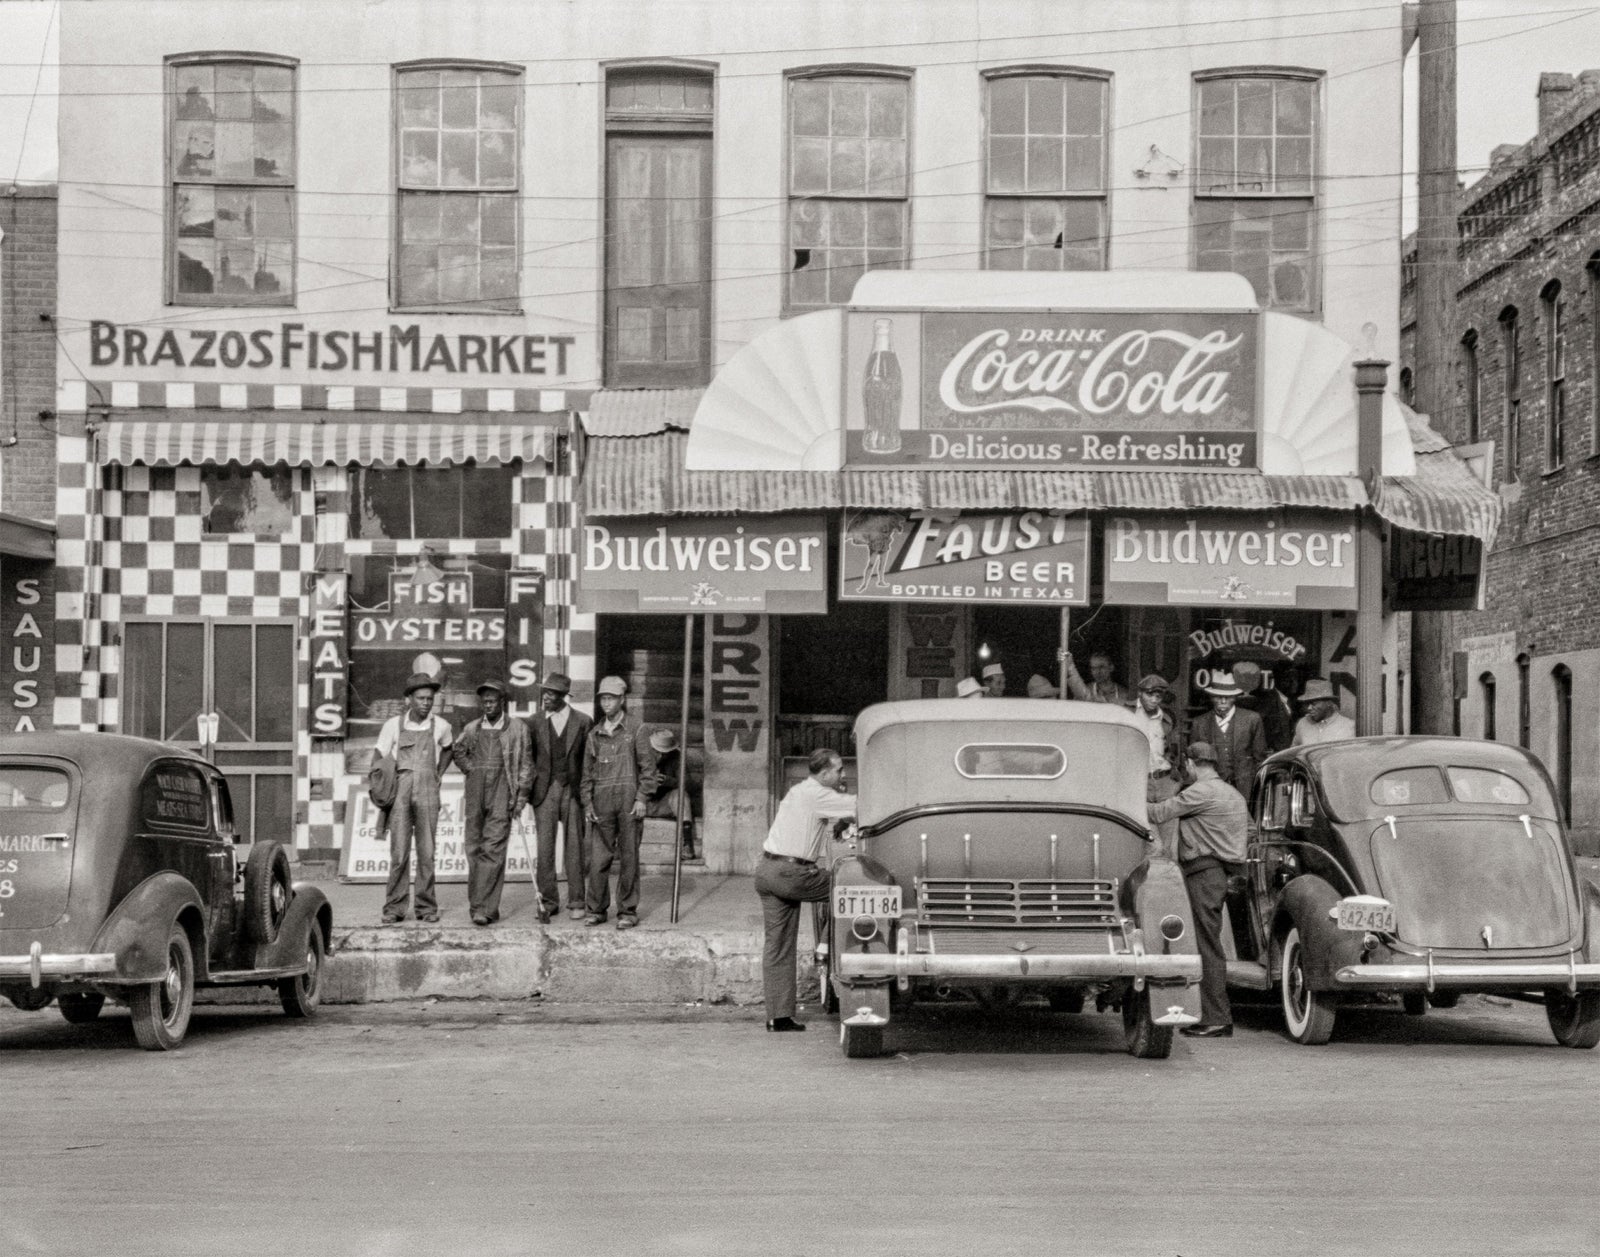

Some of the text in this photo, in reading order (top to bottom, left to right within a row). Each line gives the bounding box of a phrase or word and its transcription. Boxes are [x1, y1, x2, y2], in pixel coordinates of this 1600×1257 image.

[90, 320, 575, 375] BRAZOS FISH MARKET
[1017, 328, 1107, 342] DRINK
[939, 328, 1243, 414] Coca-Cola
[928, 433, 1062, 460] Delicious
[1082, 434, 1245, 466] Refreshing
[583, 525, 821, 571] Budweiser
[900, 509, 1077, 570] FAUST
[1113, 517, 1353, 568] Budweiser
[394, 581, 467, 604] FISH
[892, 584, 1075, 598] BOTTLED IN TEXAS
[985, 560, 1075, 583] BEER
[358, 617, 505, 642] OYSTERS
[1189, 618, 1306, 661] Budweiser
[314, 578, 343, 732] MEATS
